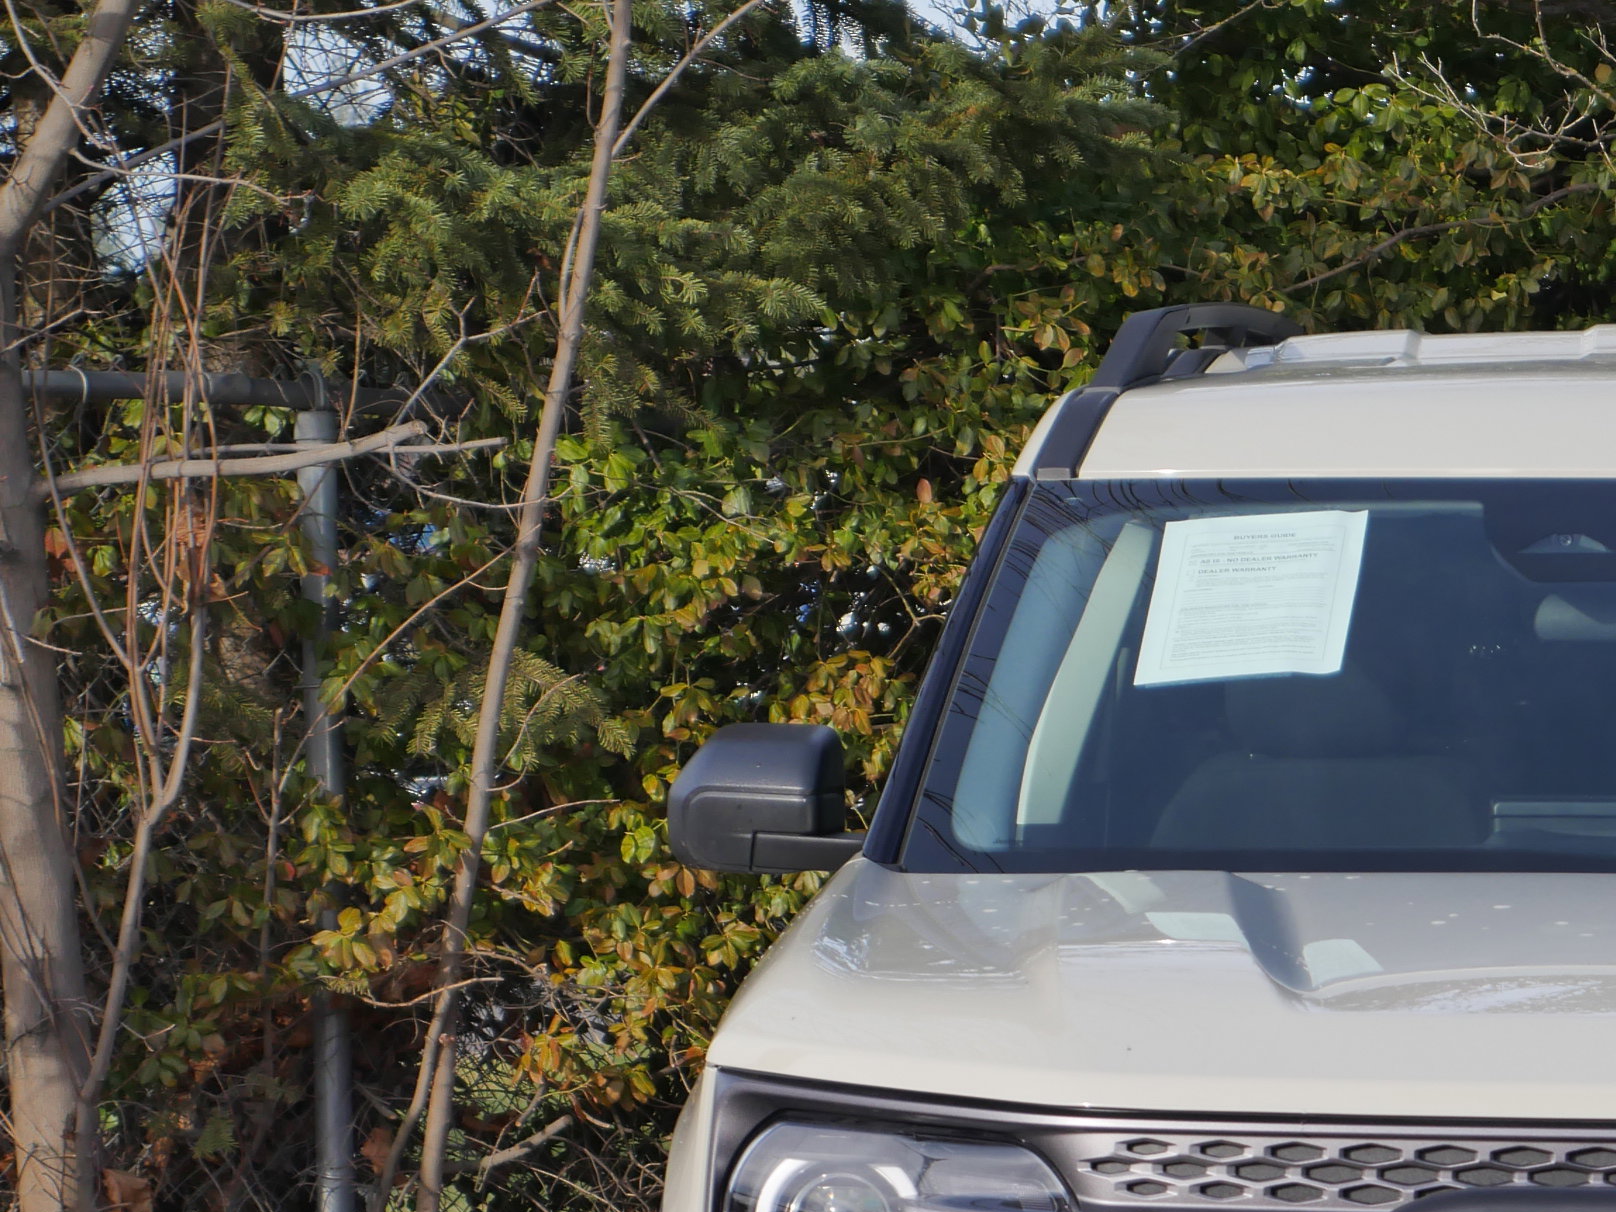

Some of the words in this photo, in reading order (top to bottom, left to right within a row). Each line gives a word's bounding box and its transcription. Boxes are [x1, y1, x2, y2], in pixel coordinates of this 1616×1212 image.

[1233, 533, 1269, 541] BUYERS
[1270, 531, 1297, 540] GUIDE
[1240, 555, 1272, 563] DEALER
[1273, 552, 1319, 562] WARRANTY
[1198, 567, 1230, 575] DEALER
[1231, 565, 1277, 574] WARRANTY
